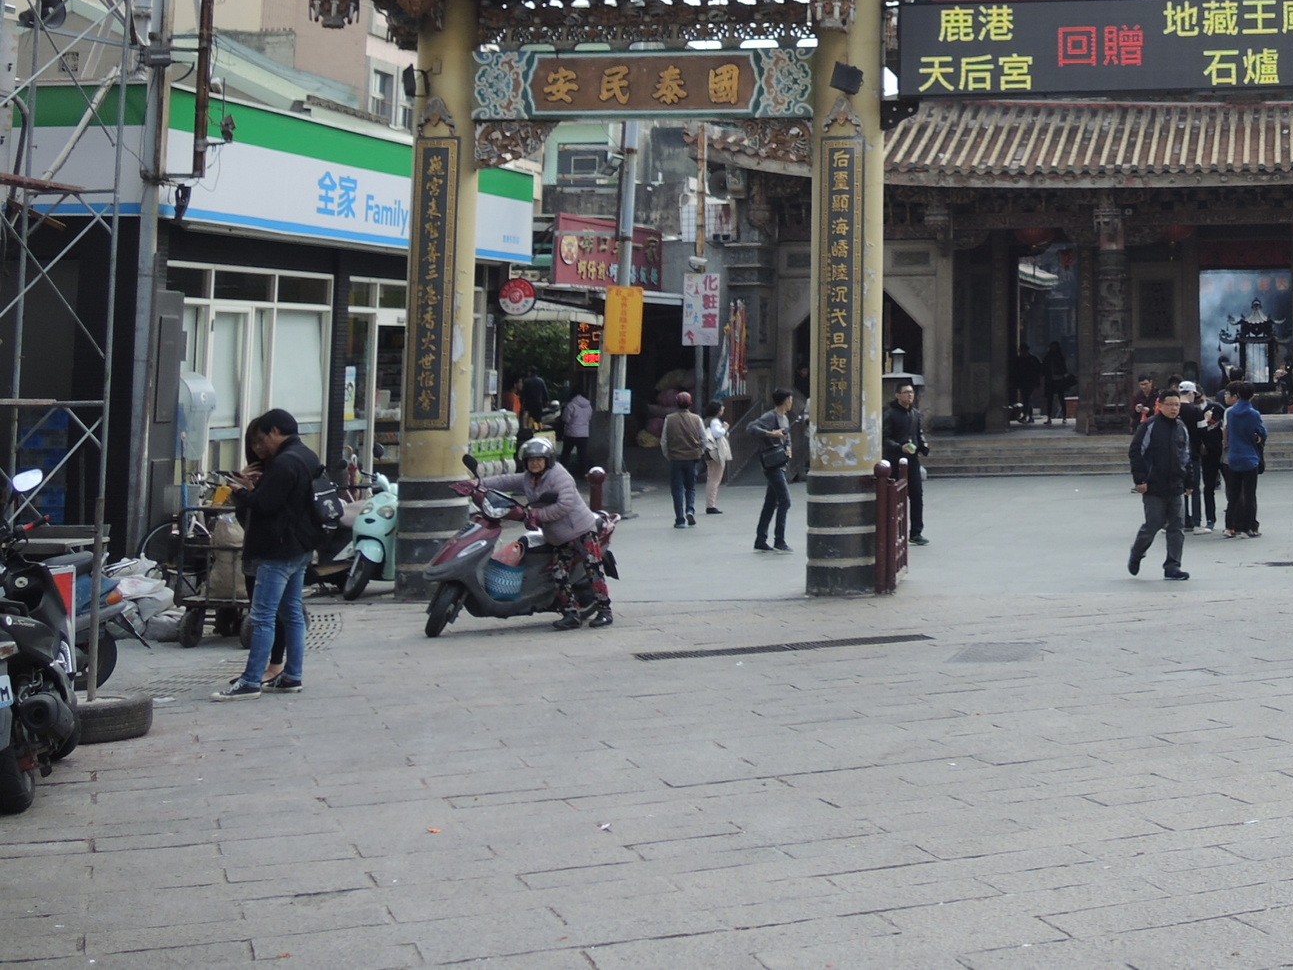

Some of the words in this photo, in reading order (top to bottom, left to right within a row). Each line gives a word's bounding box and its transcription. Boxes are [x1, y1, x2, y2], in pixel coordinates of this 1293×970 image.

[938, 4, 1014, 42] 鹿港
[1057, 24, 1144, 67] 回贈
[918, 53, 1033, 92] 天后宮
[1203, 48, 1279, 85] 石爐
[316, 170, 358, 219] 全家
